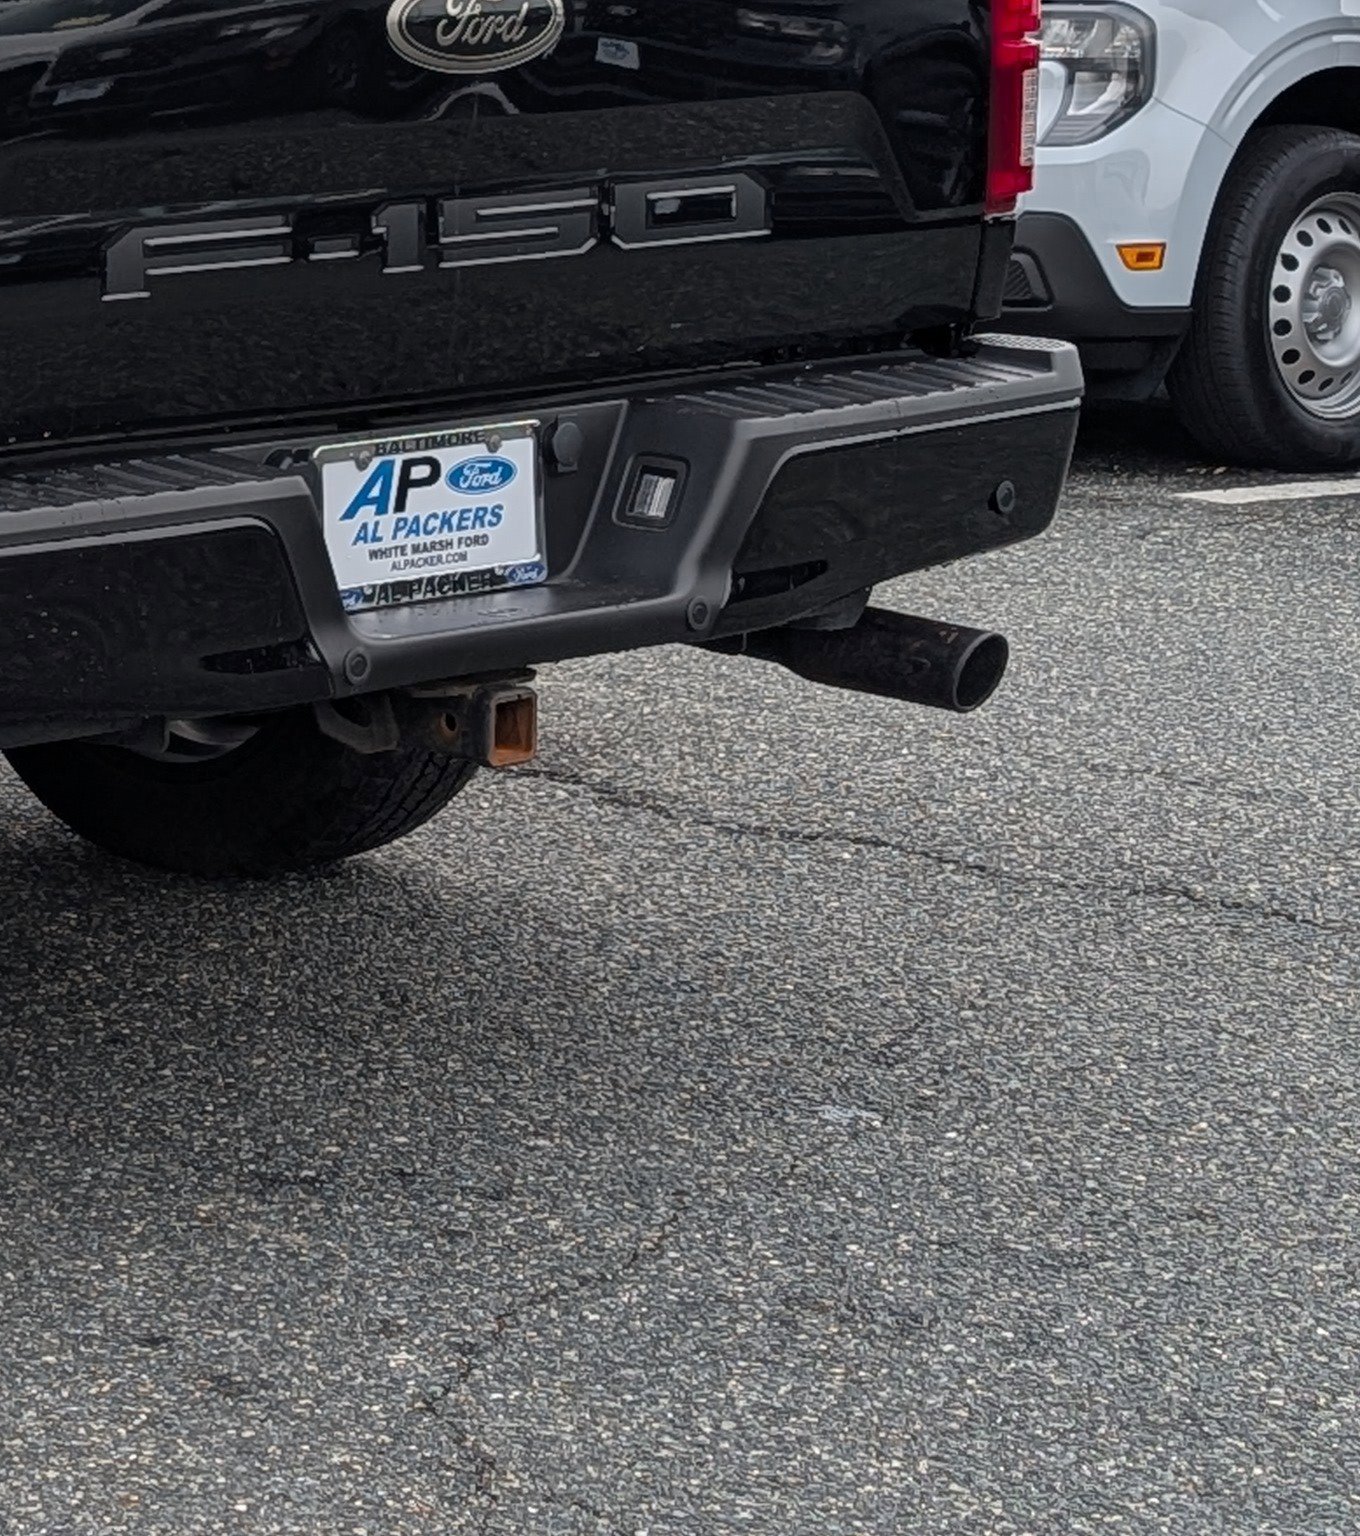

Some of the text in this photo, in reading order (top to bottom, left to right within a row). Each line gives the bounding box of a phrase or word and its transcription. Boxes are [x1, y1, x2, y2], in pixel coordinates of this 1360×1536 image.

[374, 431, 486, 455] BALTIMORE
[339, 456, 503, 521] AP Ford
[351, 504, 504, 546] AL PACKERS
[368, 534, 489, 561] WHITE MARSH FORD
[390, 551, 468, 572] ALPACKER.COM
[376, 585, 402, 605] AL
